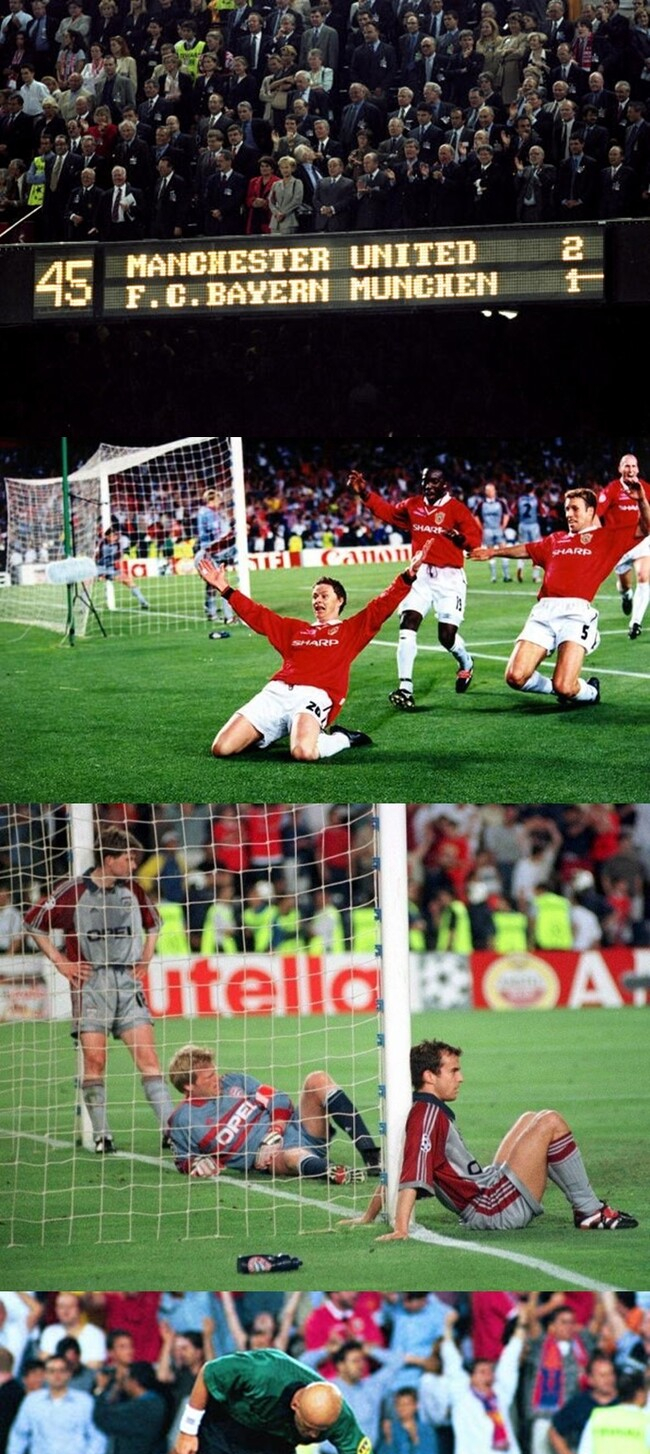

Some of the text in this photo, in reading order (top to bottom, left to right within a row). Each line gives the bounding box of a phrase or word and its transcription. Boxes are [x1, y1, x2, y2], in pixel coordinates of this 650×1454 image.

[126, 236, 584, 278] MANCHESTER UNITED 2
[35, 260, 93, 307] 45
[350, 272, 498, 301] MUNCHEN
[565, 268, 581, 293] 1
[522, 504, 532, 518] 2
[321, 548, 409, 566] Canon
[552, 547, 592, 556] SHARP
[581, 625, 589, 640] 5
[291, 638, 339, 647] SHARP
[305, 701, 321, 718] 20
[141, 955, 380, 1018] utella
